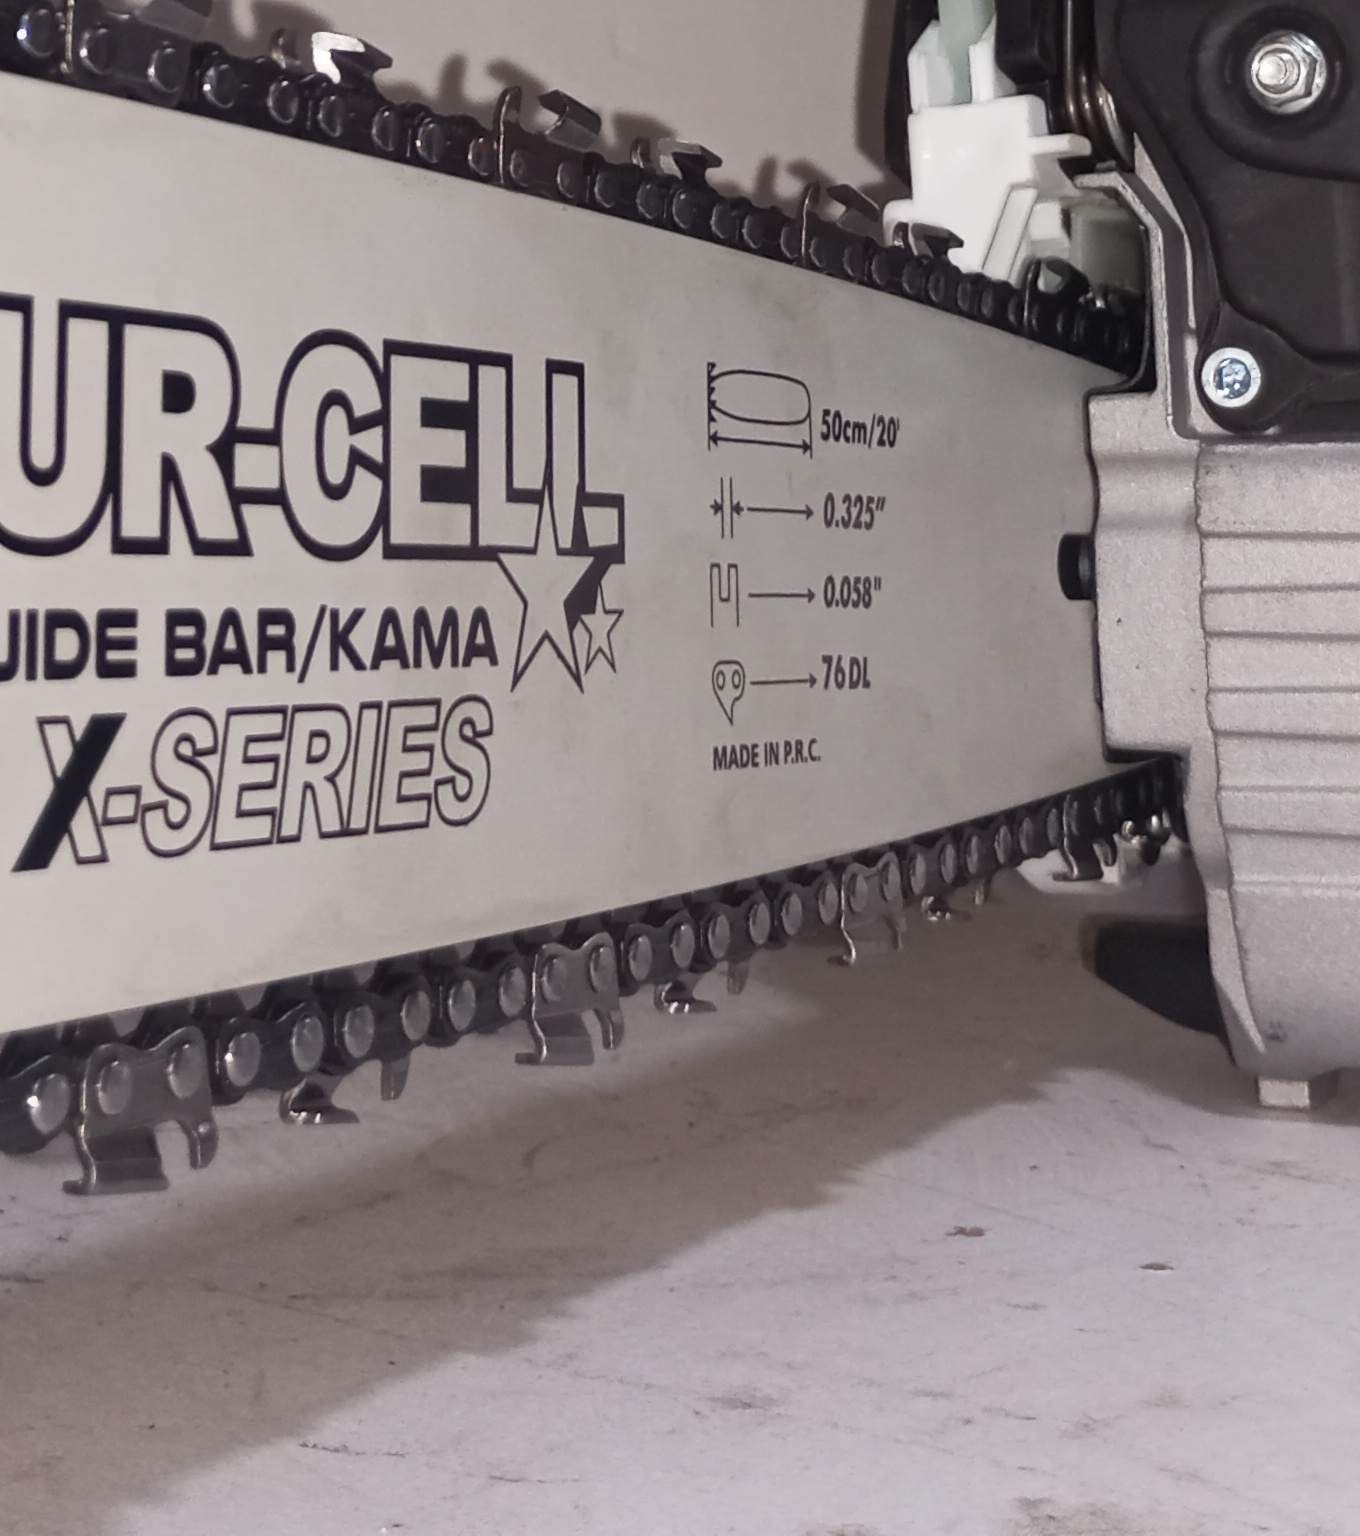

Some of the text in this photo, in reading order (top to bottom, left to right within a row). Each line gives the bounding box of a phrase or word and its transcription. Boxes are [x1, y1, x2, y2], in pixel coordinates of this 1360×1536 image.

[164, 604, 499, 684] BAR/KAMA
[11, 694, 494, 873] X-SERIES
[712, 737, 821, 771] MADE IN P.R.C.
